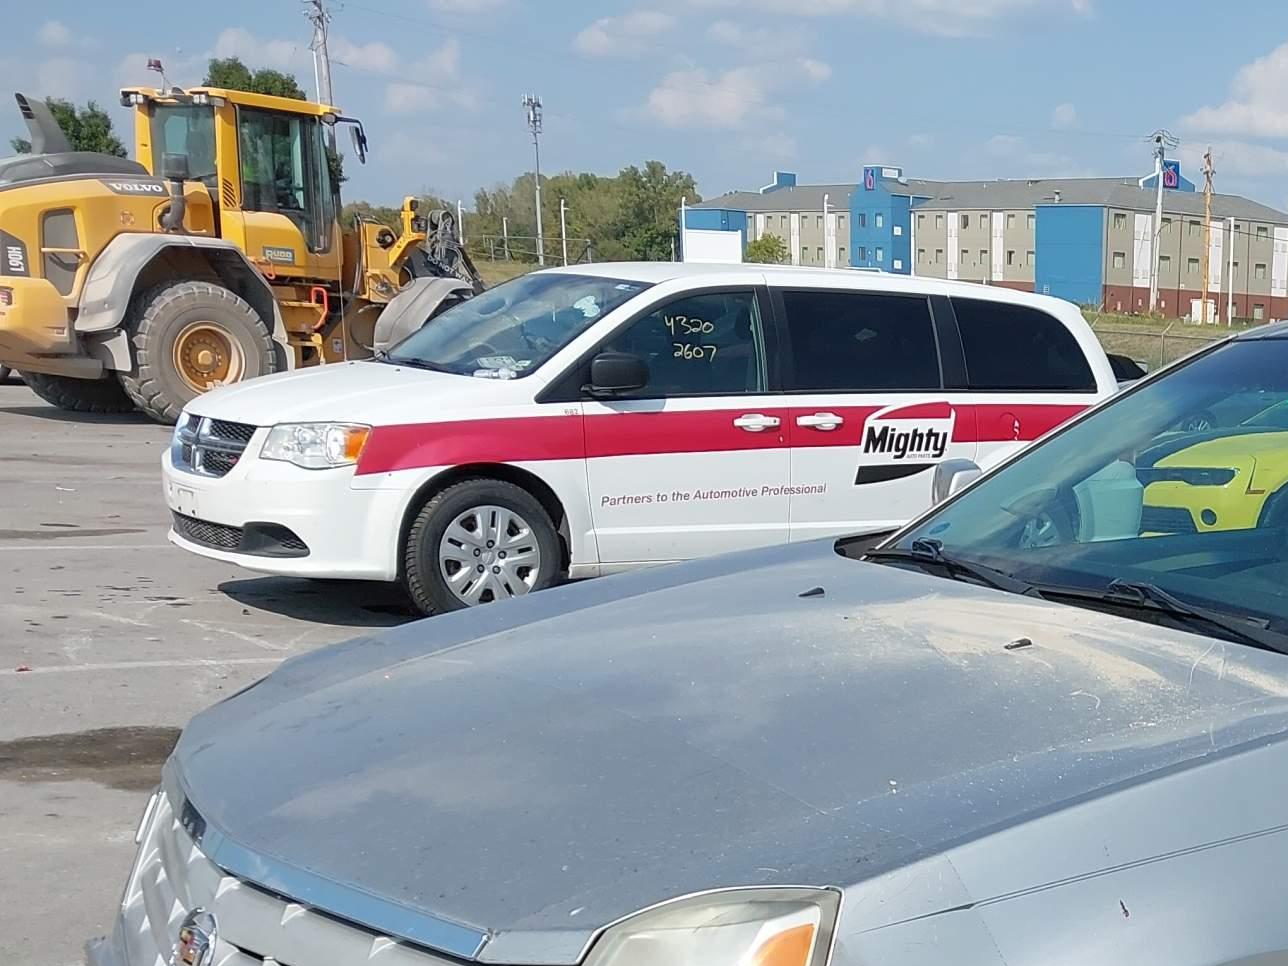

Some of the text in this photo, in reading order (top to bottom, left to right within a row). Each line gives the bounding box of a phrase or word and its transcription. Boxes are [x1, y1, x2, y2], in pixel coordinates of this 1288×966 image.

[109, 182, 164, 193] VOLVO
[7, 246, 25, 272] L90H
[664, 315, 715, 336] 4320
[673, 343, 717, 363] 2607
[863, 425, 948, 460] Mighty
[601, 482, 827, 507] Partners to the Automotive Professional
